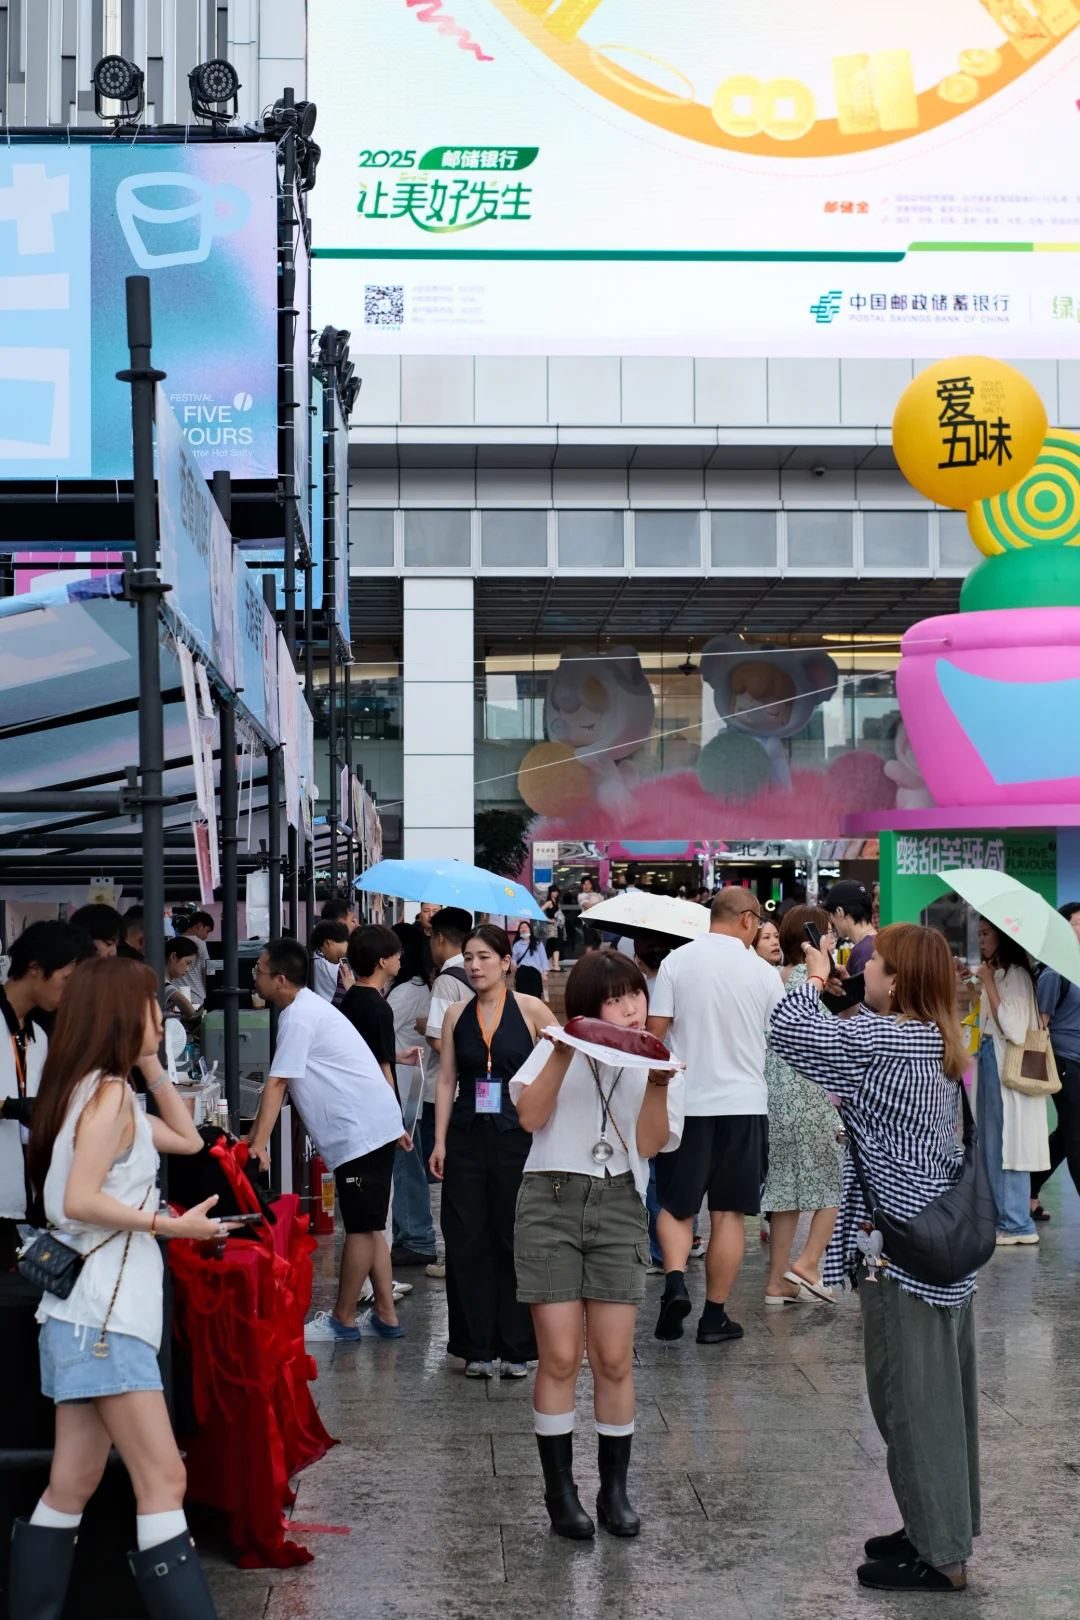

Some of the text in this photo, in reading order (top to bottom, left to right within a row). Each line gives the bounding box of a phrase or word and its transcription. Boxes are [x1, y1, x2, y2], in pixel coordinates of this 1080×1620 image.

[358, 150, 417, 168] 2025
[441, 149, 518, 169] 邮储银行
[356, 179, 533, 230] 让美好发生
[849, 293, 1010, 312] 中国邮政储蓄银行
[1052, 295, 1080, 323] 绿
[850, 314, 1010, 323] POSTAL SAVINGS BANK OF CHINA
[170, 393, 214, 402] FESTIVAL
[936, 376, 975, 421] 爱
[184, 405, 232, 423] FIVE
[938, 416, 1013, 470] 五味
[212, 449, 228, 457] Hot
[230, 449, 253, 458] Salty
[1007, 846, 1049, 858] THE FIVE
[1007, 859, 1057, 870] FLAVOURS
